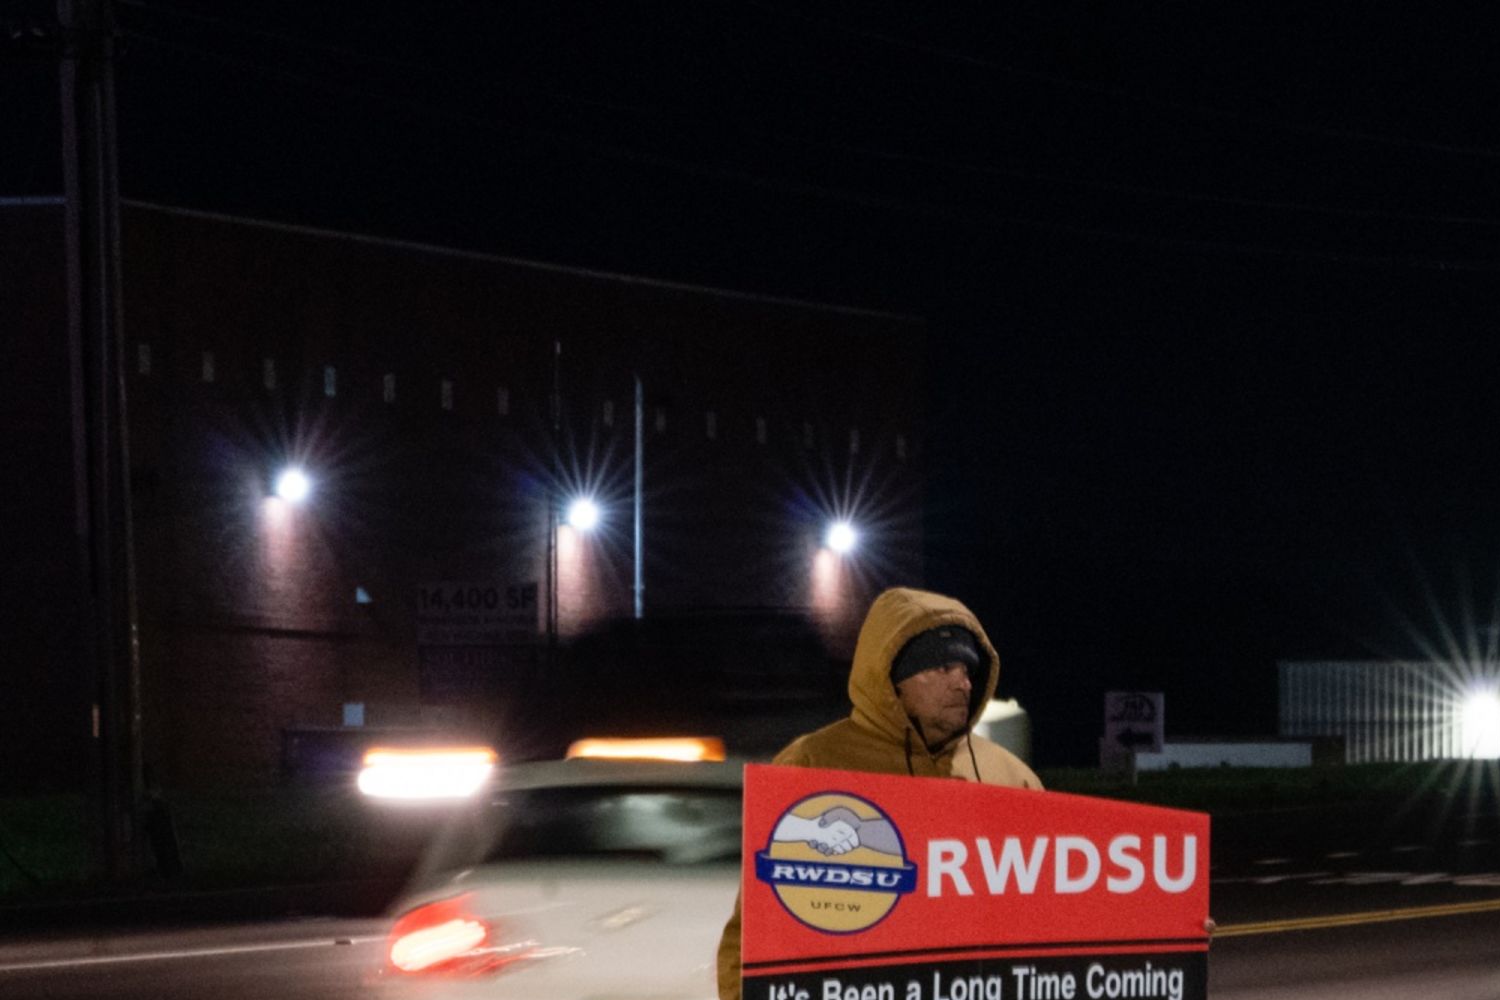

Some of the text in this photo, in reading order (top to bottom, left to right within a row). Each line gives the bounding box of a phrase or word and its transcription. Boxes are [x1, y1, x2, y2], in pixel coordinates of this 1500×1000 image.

[421, 588, 499, 611] 14,400
[771, 864, 903, 888] RWDSU
[927, 835, 1197, 897] RWDSU
[810, 900, 862, 913] UFCW
